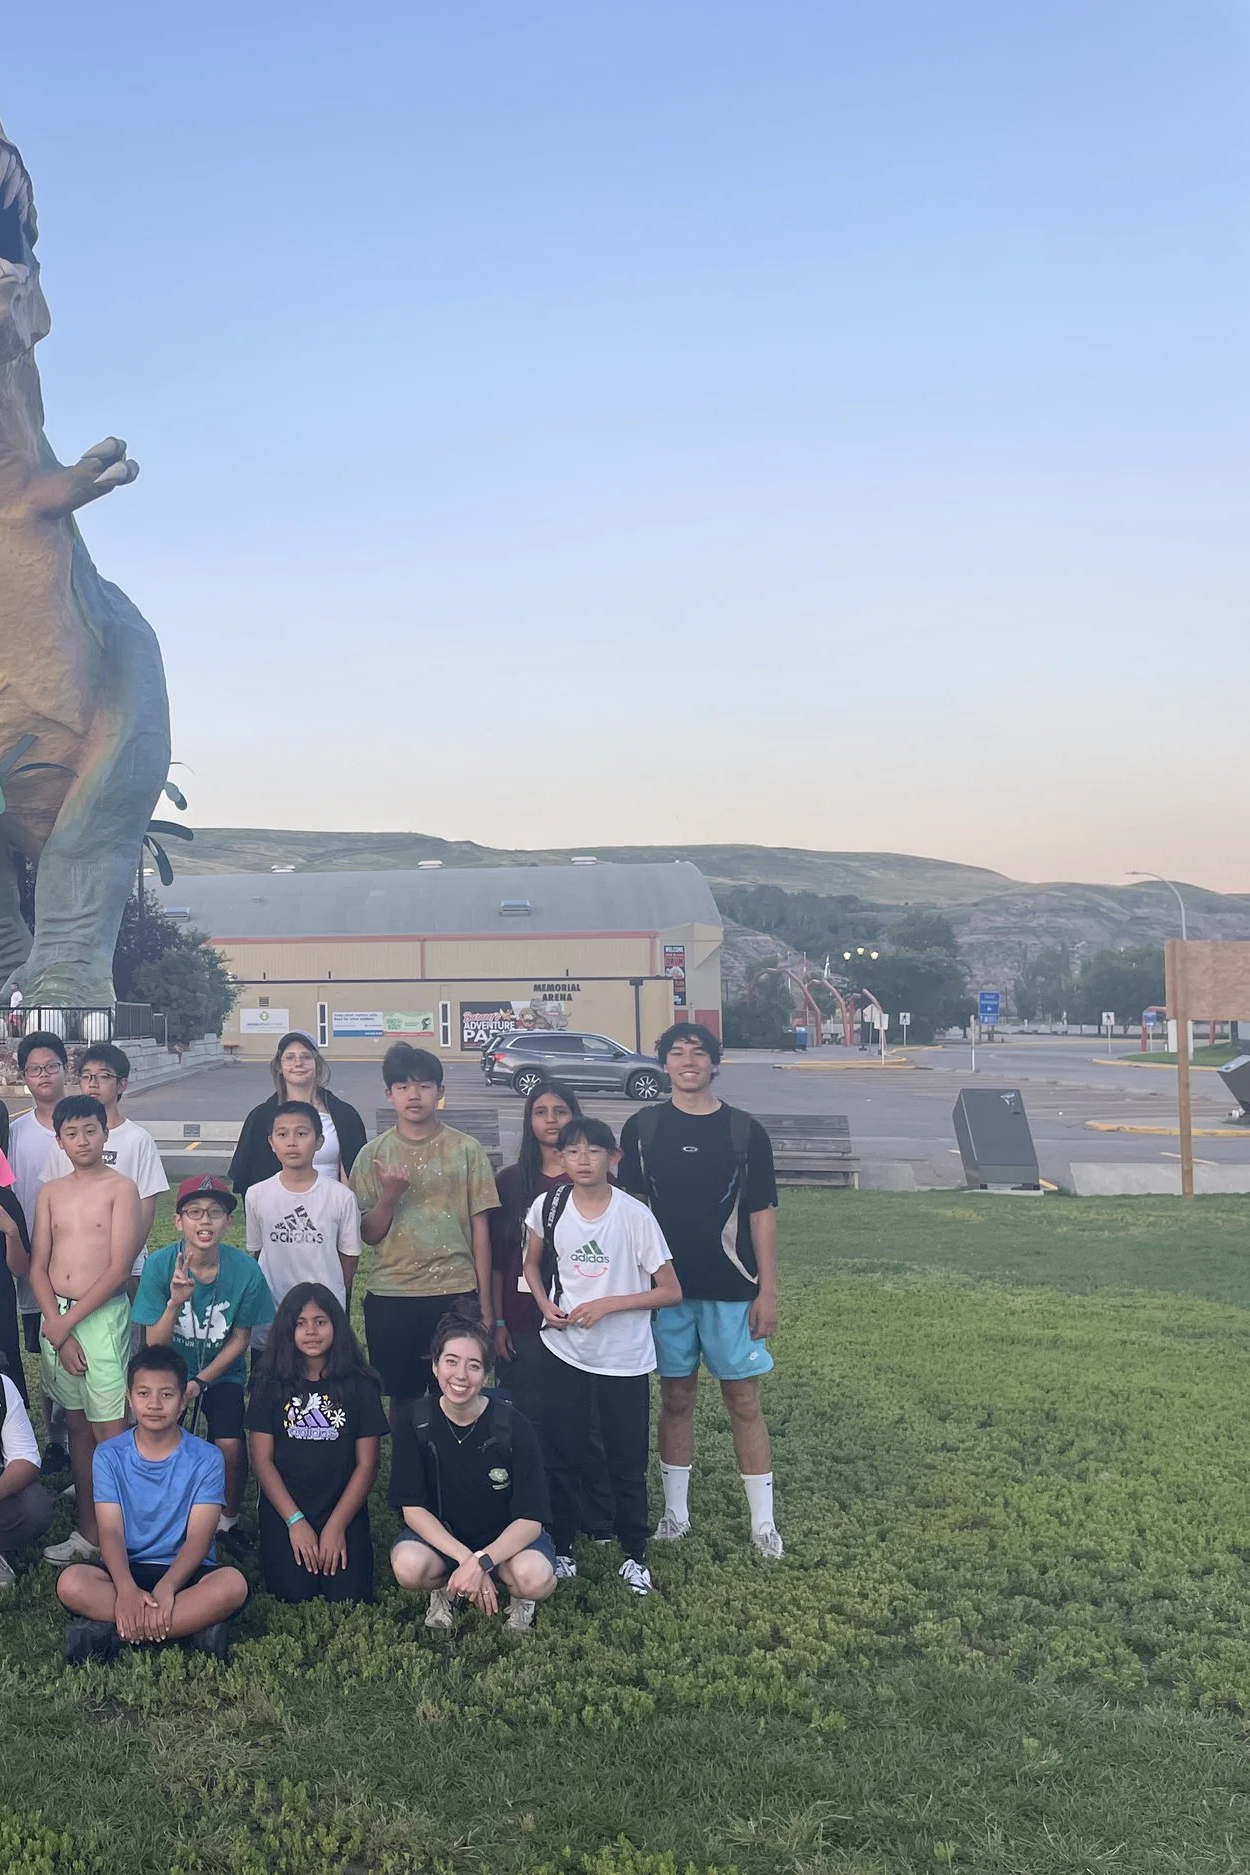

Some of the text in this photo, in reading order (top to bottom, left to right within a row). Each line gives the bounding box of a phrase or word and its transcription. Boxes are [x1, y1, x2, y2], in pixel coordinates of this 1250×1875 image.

[533, 984, 581, 992] MEMORIAL
[542, 993, 573, 1001] ARENA
[464, 1021, 515, 1030] ADVENTURE
[463, 1029, 504, 1043] PA
[270, 1229, 324, 1244] adidas
[571, 1253, 610, 1263] adidas
[287, 1424, 339, 1440] adidas
